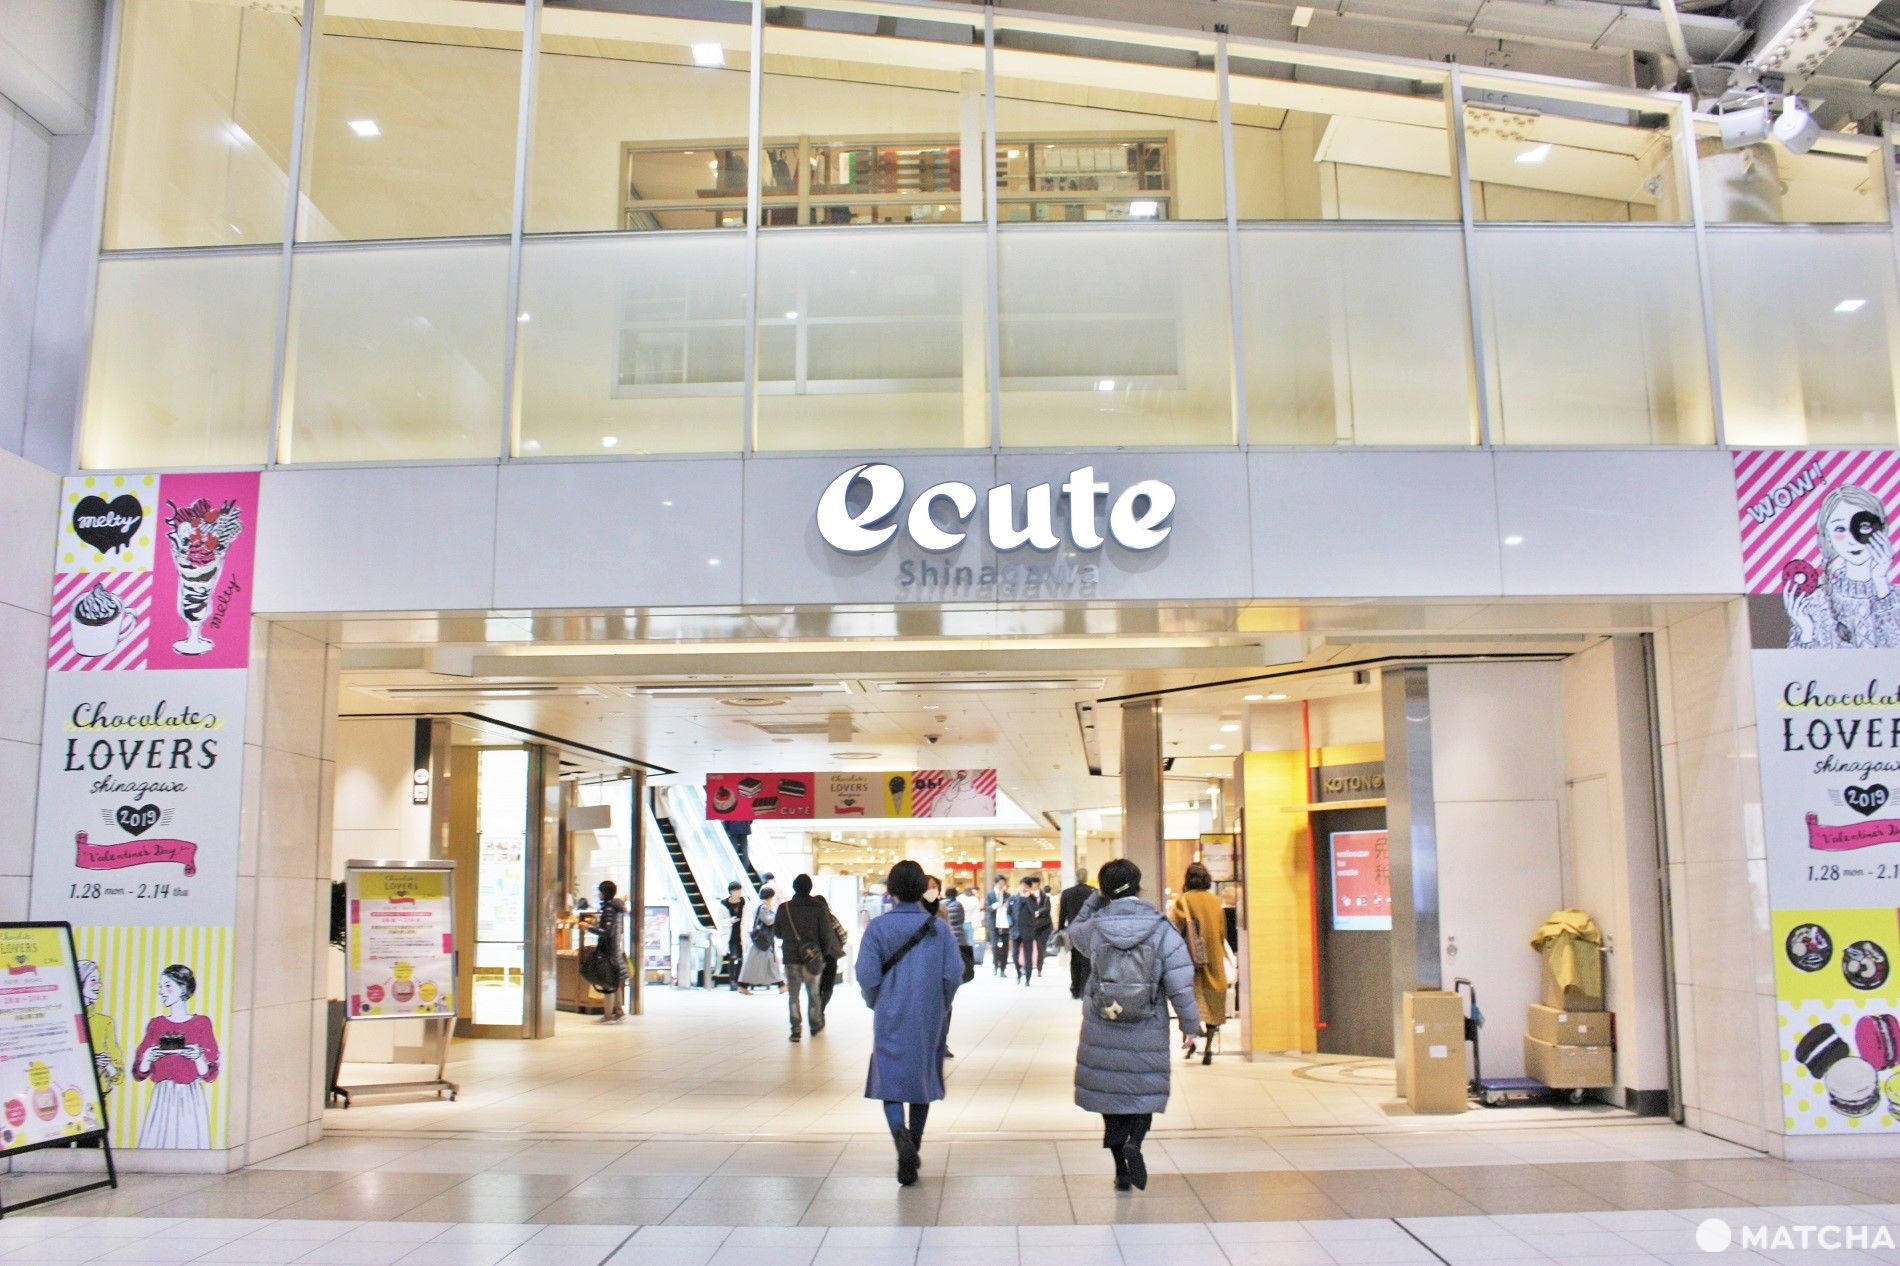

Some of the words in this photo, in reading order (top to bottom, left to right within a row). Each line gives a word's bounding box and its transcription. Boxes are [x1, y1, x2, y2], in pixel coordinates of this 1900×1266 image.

[1747, 460, 1828, 524] WOW!
[816, 462, 1177, 554] ecute
[77, 511, 141, 534] melty
[900, 559, 1100, 589] Shinagawa
[211, 574, 242, 629] melty
[63, 738, 219, 772] LOVERS
[89, 774, 188, 802] shinagawa
[1848, 789, 1885, 808] 2019
[120, 809, 158, 828] 2019
[780, 806, 811, 815] CUTE
[1807, 864, 1840, 881] 1.28
[69, 883, 102, 900] 1.28
[137, 883, 170, 900] 2.14
